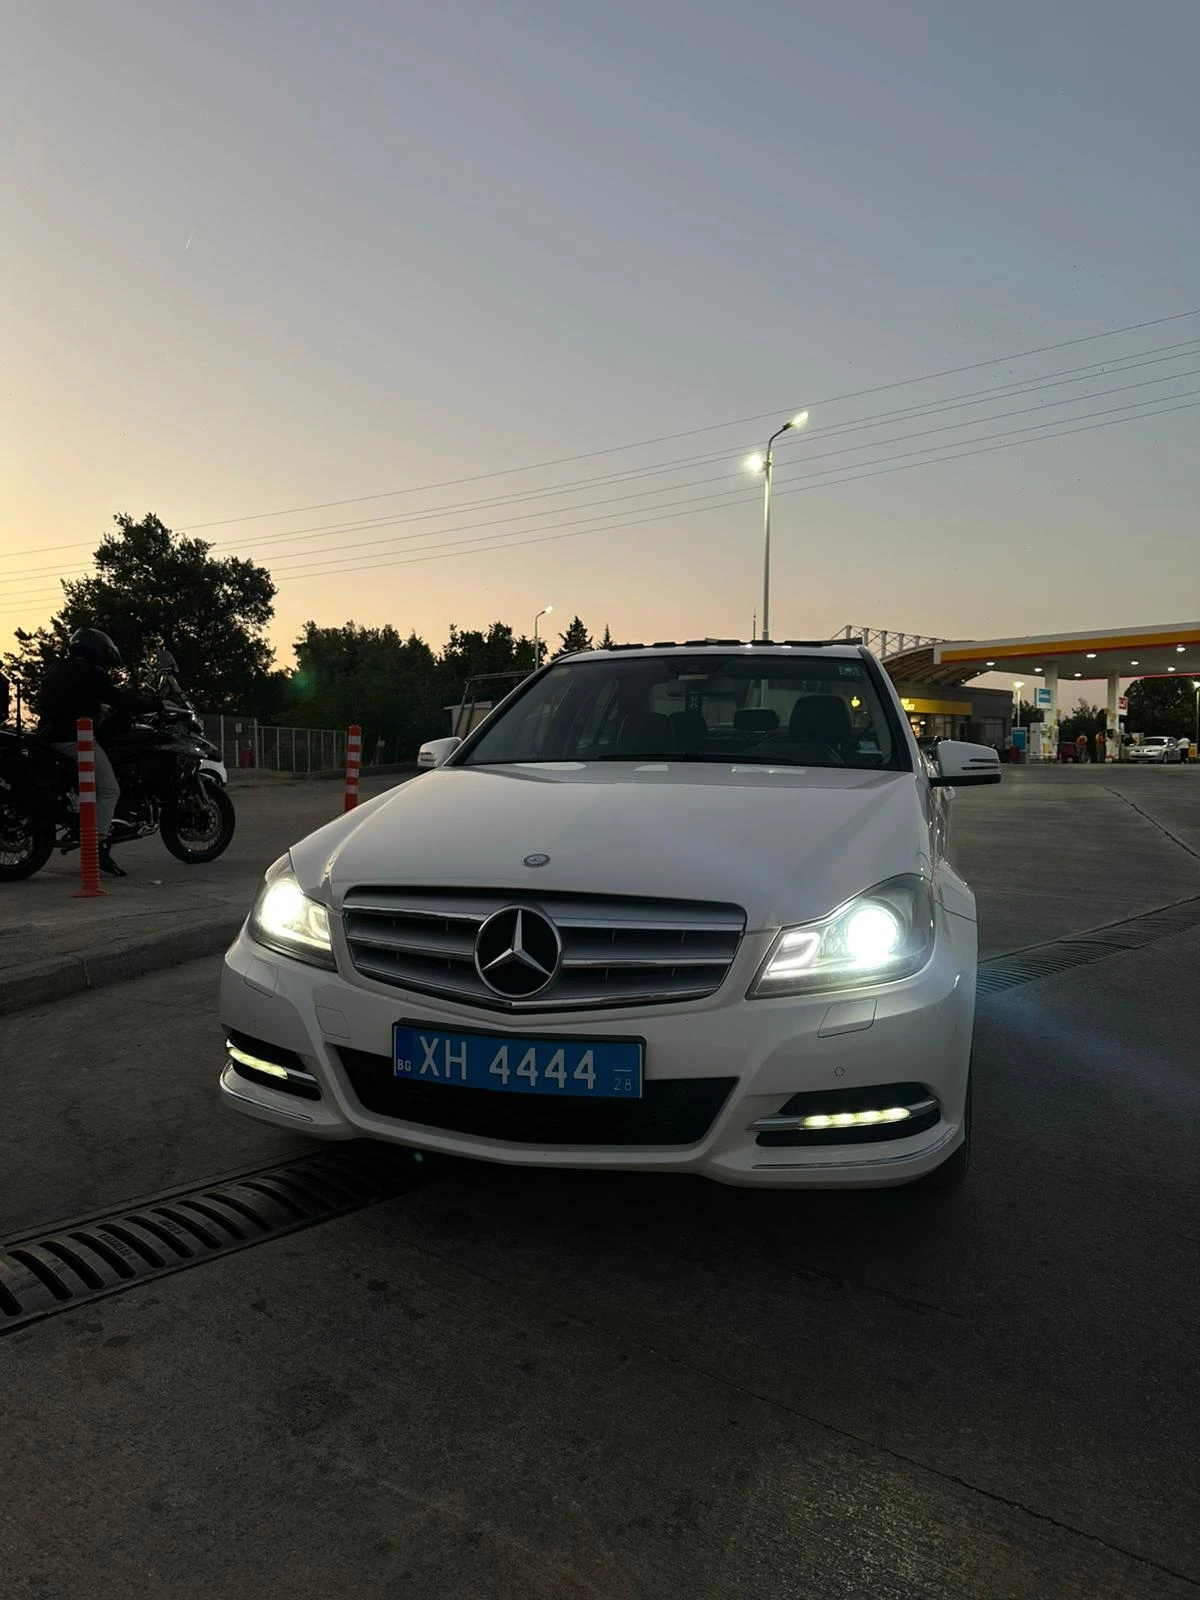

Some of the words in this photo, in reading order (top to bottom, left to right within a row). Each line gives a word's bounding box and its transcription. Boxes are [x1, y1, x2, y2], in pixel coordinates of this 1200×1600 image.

[397, 1058, 412, 1072] BG
[419, 1035, 467, 1080] XH
[488, 1045, 597, 1090] 4444
[613, 1078, 632, 1092] 28
